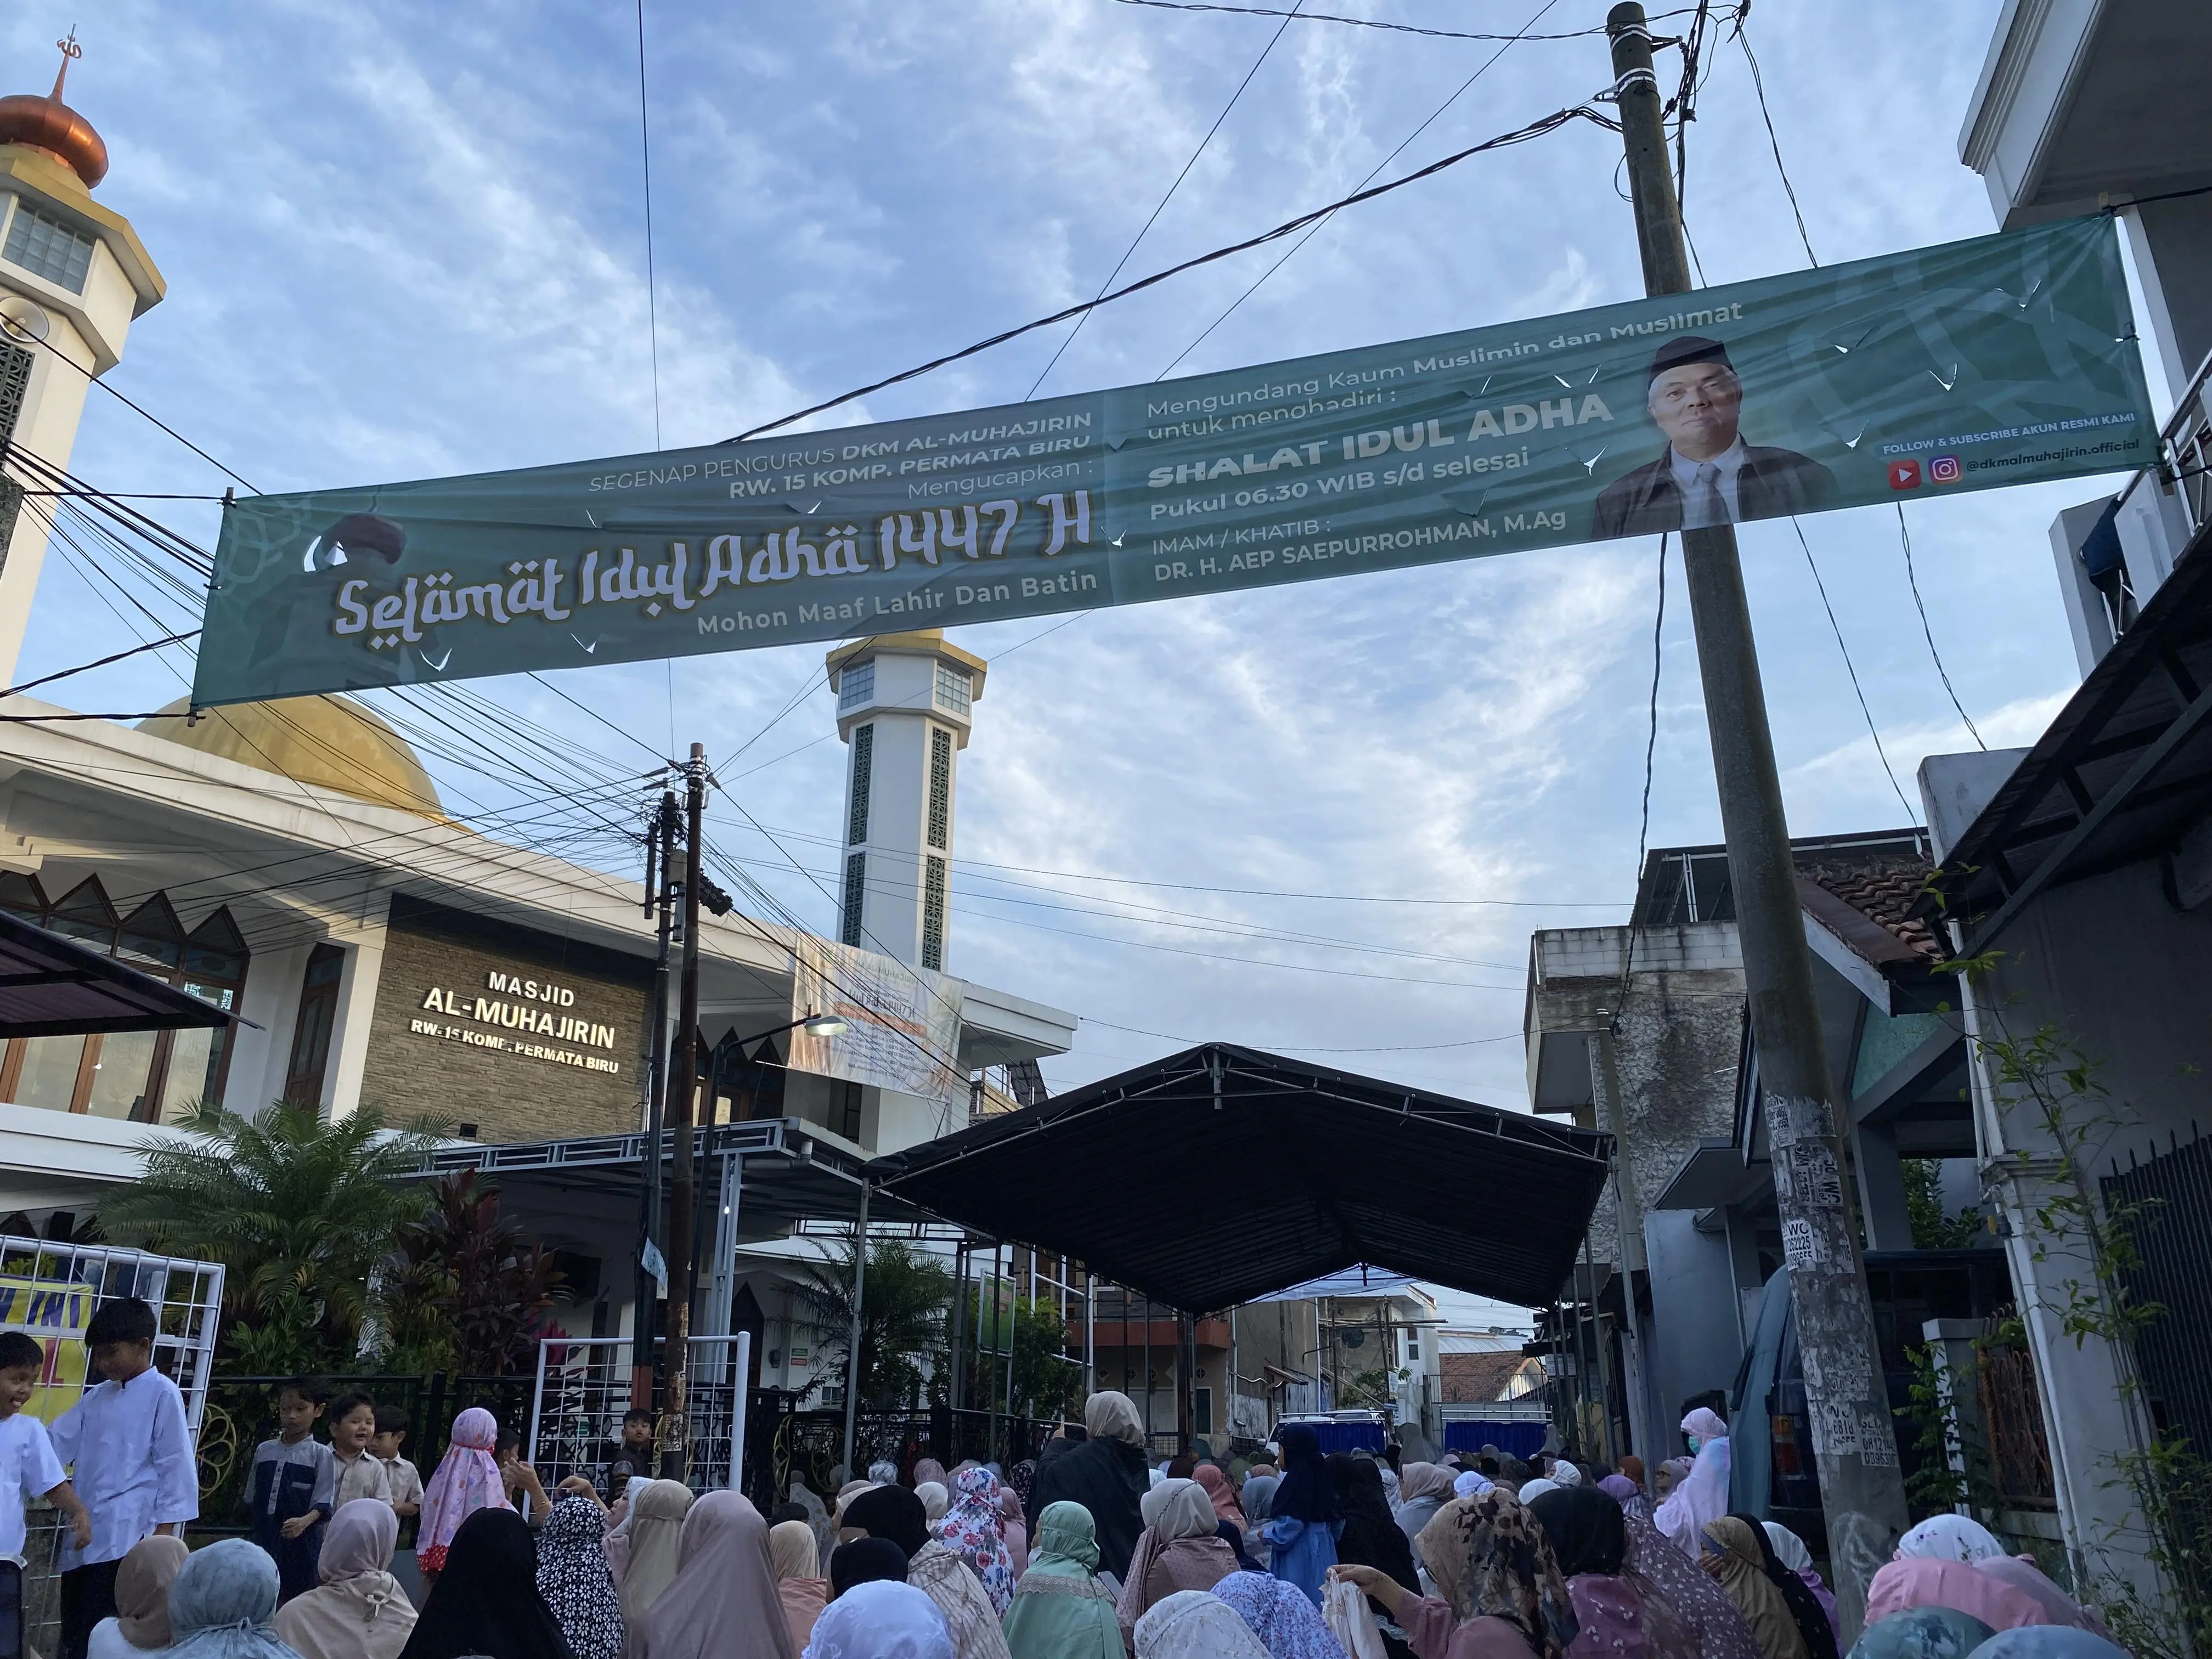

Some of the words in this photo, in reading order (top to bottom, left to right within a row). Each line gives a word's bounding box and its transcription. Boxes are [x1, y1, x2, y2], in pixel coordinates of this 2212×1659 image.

[1148, 380, 1318, 418] Mengundang
[1329, 366, 1404, 388] Kaum
[1414, 341, 1539, 374] Muslimin
[1549, 330, 1601, 349] dan
[1609, 303, 1742, 339] Muslimat
[1148, 417, 1222, 439] untuk
[1231, 386, 1381, 428] menghadiri
[1148, 440, 1327, 488] SHALAT
[1344, 419, 1454, 460] IDUL
[1467, 394, 1614, 441] ADHA
[1883, 439, 1934, 455] FOLLOW
[1938, 438, 1946, 447] &
[1950, 428, 2019, 445] SUBSCRIBE
[2022, 423, 2058, 436] AKUN
[2061, 418, 2100, 431] RESMI
[2102, 413, 2135, 424] KAMI
[588, 464, 696, 492] SEGENAP
[704, 447, 835, 477] PENGURUS
[842, 441, 899, 462] DKM
[906, 413, 1092, 452] AL-MUHAJIRIN
[730, 477, 776, 499] RW.
[783, 473, 806, 492] 15
[812, 464, 892, 488] KOMP.
[900, 447, 1021, 475] PERMATA
[1029, 435, 1090, 456] BIRU
[908, 461, 1080, 500] Mengucapkan
[1150, 494, 1226, 520] Pukul
[1235, 482, 1308, 507] 06.30
[1316, 471, 1375, 494] WIB
[1383, 462, 1424, 487] s/d
[1433, 447, 1528, 479] selesai
[1966, 439, 2140, 472] @dkmalmuhajirin.official
[881, 499, 1019, 570] 1447
[1036, 490, 1090, 555] H
[1153, 533, 1214, 555] IMAM
[1235, 520, 1319, 544] KHATIB
[1154, 562, 1193, 581] DR.
[1200, 558, 1222, 575] H.
[1229, 550, 1275, 572] AEP
[1283, 518, 1497, 564] SAEPURROHMAN,
[1505, 510, 1567, 533] M.Ag
[698, 611, 787, 634] Mohon
[798, 597, 864, 623] Maaf
[874, 591, 944, 614] Lahir
[956, 585, 1009, 604] Dan
[1022, 570, 1097, 596] Batin
[422, 987, 615, 1049] AL-MUHAJIRIN
[488, 971, 575, 1007] MASJID
[515, 1042, 583, 1067] PERMATA
[586, 1056, 619, 1074] BIRU
[1788, 1223, 1809, 1235] WC
